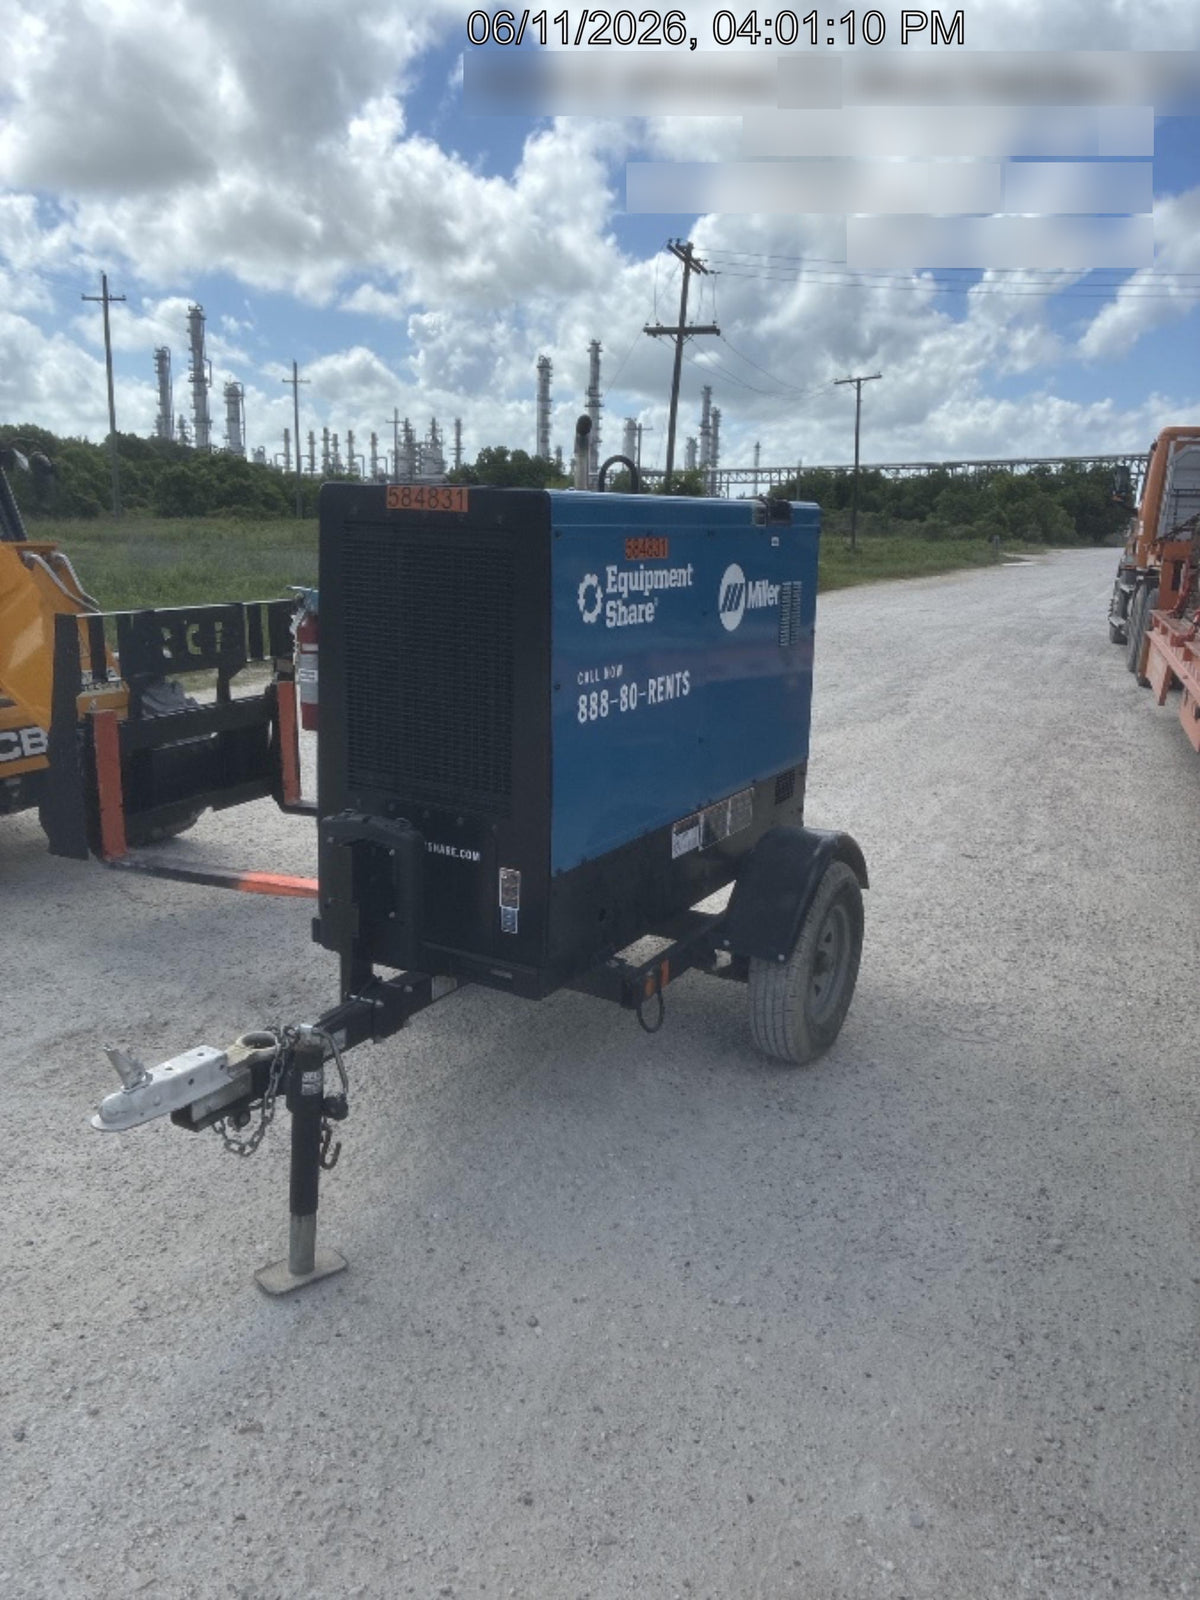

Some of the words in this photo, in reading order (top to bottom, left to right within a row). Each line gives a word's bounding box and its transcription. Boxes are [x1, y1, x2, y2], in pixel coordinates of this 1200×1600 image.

[387, 486, 464, 510] 584831
[606, 563, 693, 598] Equipment
[746, 579, 780, 608] Miller
[606, 599, 655, 628] Share
[578, 668, 600, 685] CALL
[604, 664, 623, 680] NOW
[578, 670, 690, 724] 888-80-RENTS
[424, 841, 481, 861] SHARE.COM
